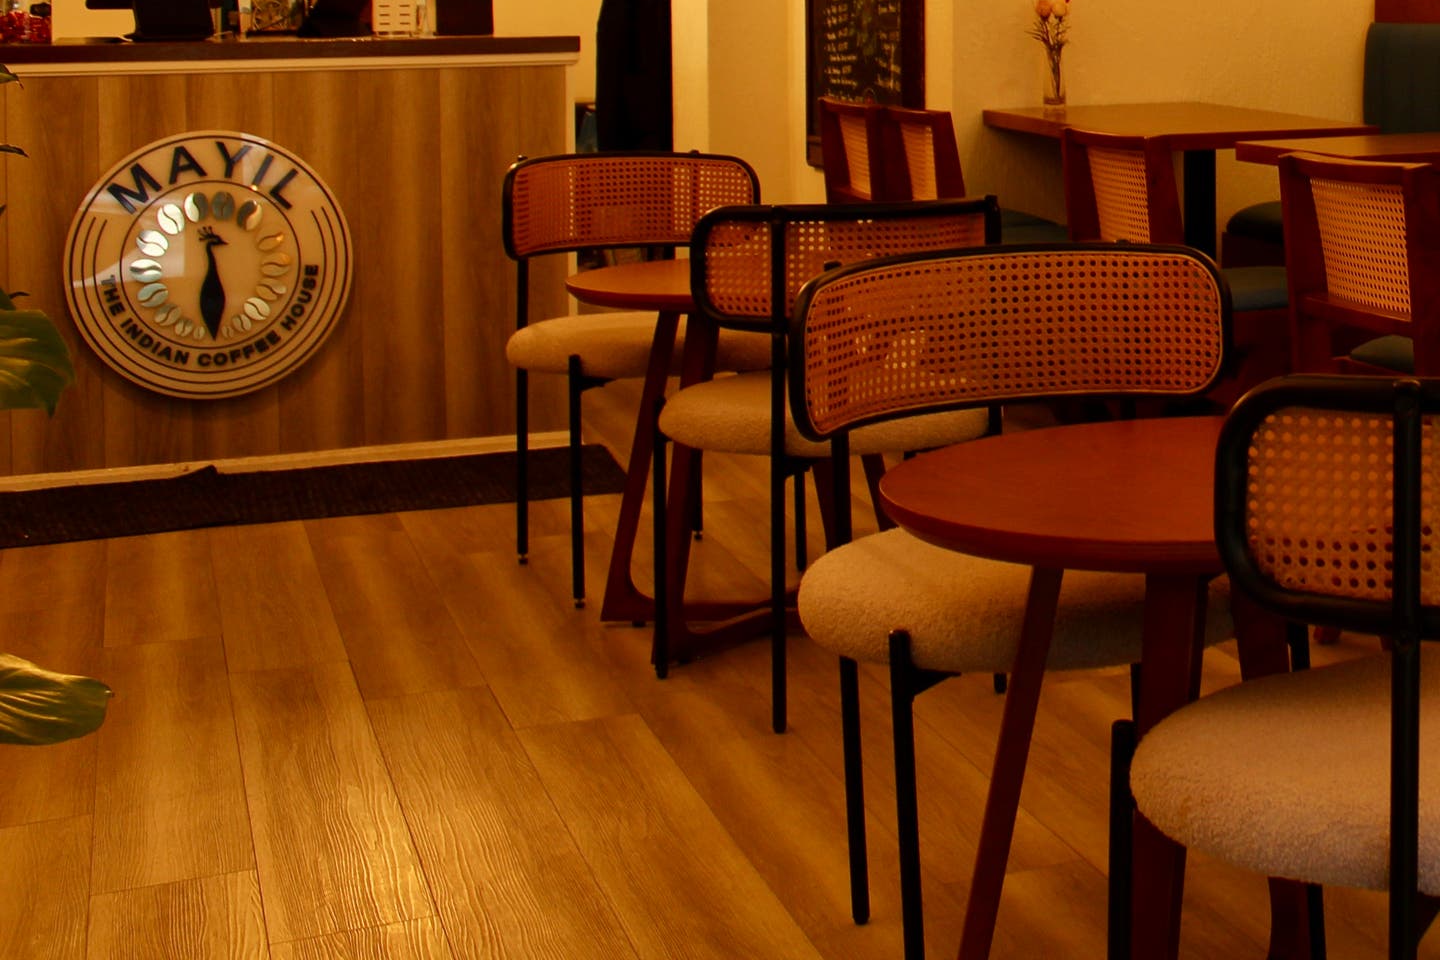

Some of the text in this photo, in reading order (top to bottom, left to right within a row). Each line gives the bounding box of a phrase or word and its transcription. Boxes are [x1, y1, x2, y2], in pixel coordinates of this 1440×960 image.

[106, 141, 299, 215] MAYIL
[101, 264, 319, 368] THE INDIAN COFFEE HOUSE
